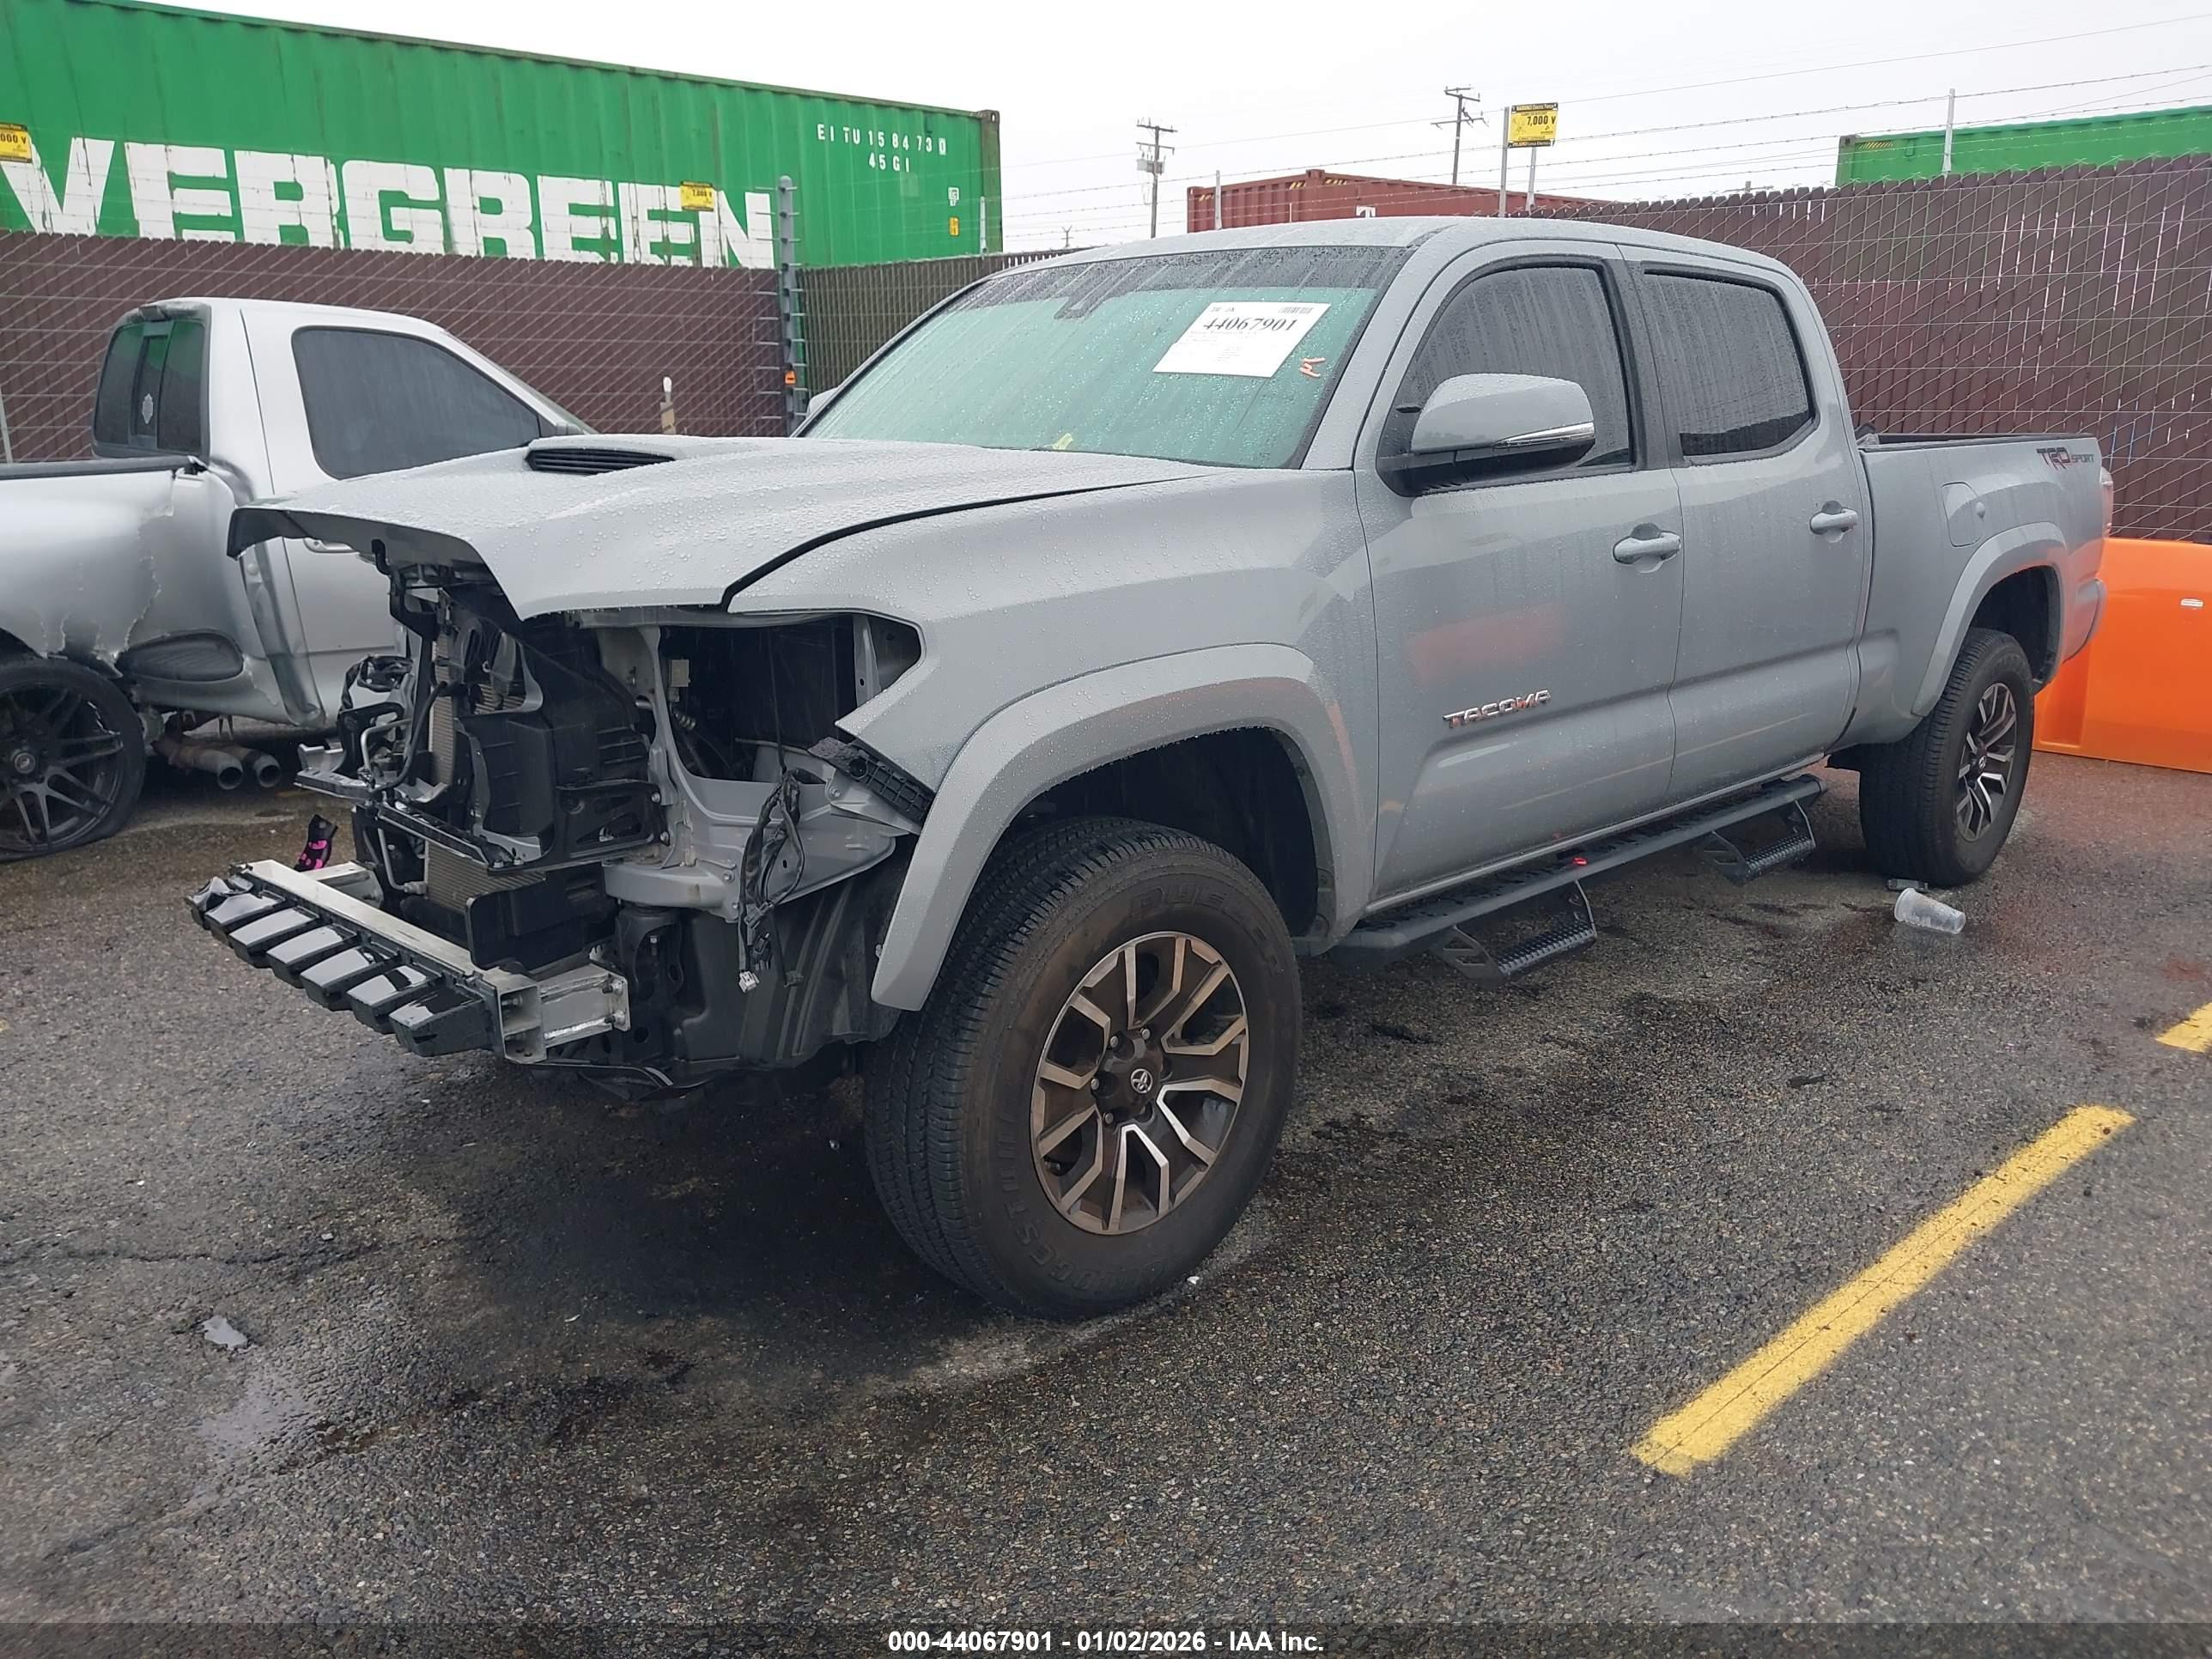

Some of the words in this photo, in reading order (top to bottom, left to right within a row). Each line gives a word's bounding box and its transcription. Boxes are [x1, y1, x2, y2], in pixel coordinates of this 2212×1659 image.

[1527, 115, 1549, 126] 7,000
[1551, 116, 1556, 125] V
[1203, 316, 1298, 332] 44067901
[2036, 447, 2071, 471] TRD
[2071, 453, 2095, 465] SPORT
[1443, 690, 1552, 729] TACOMA
